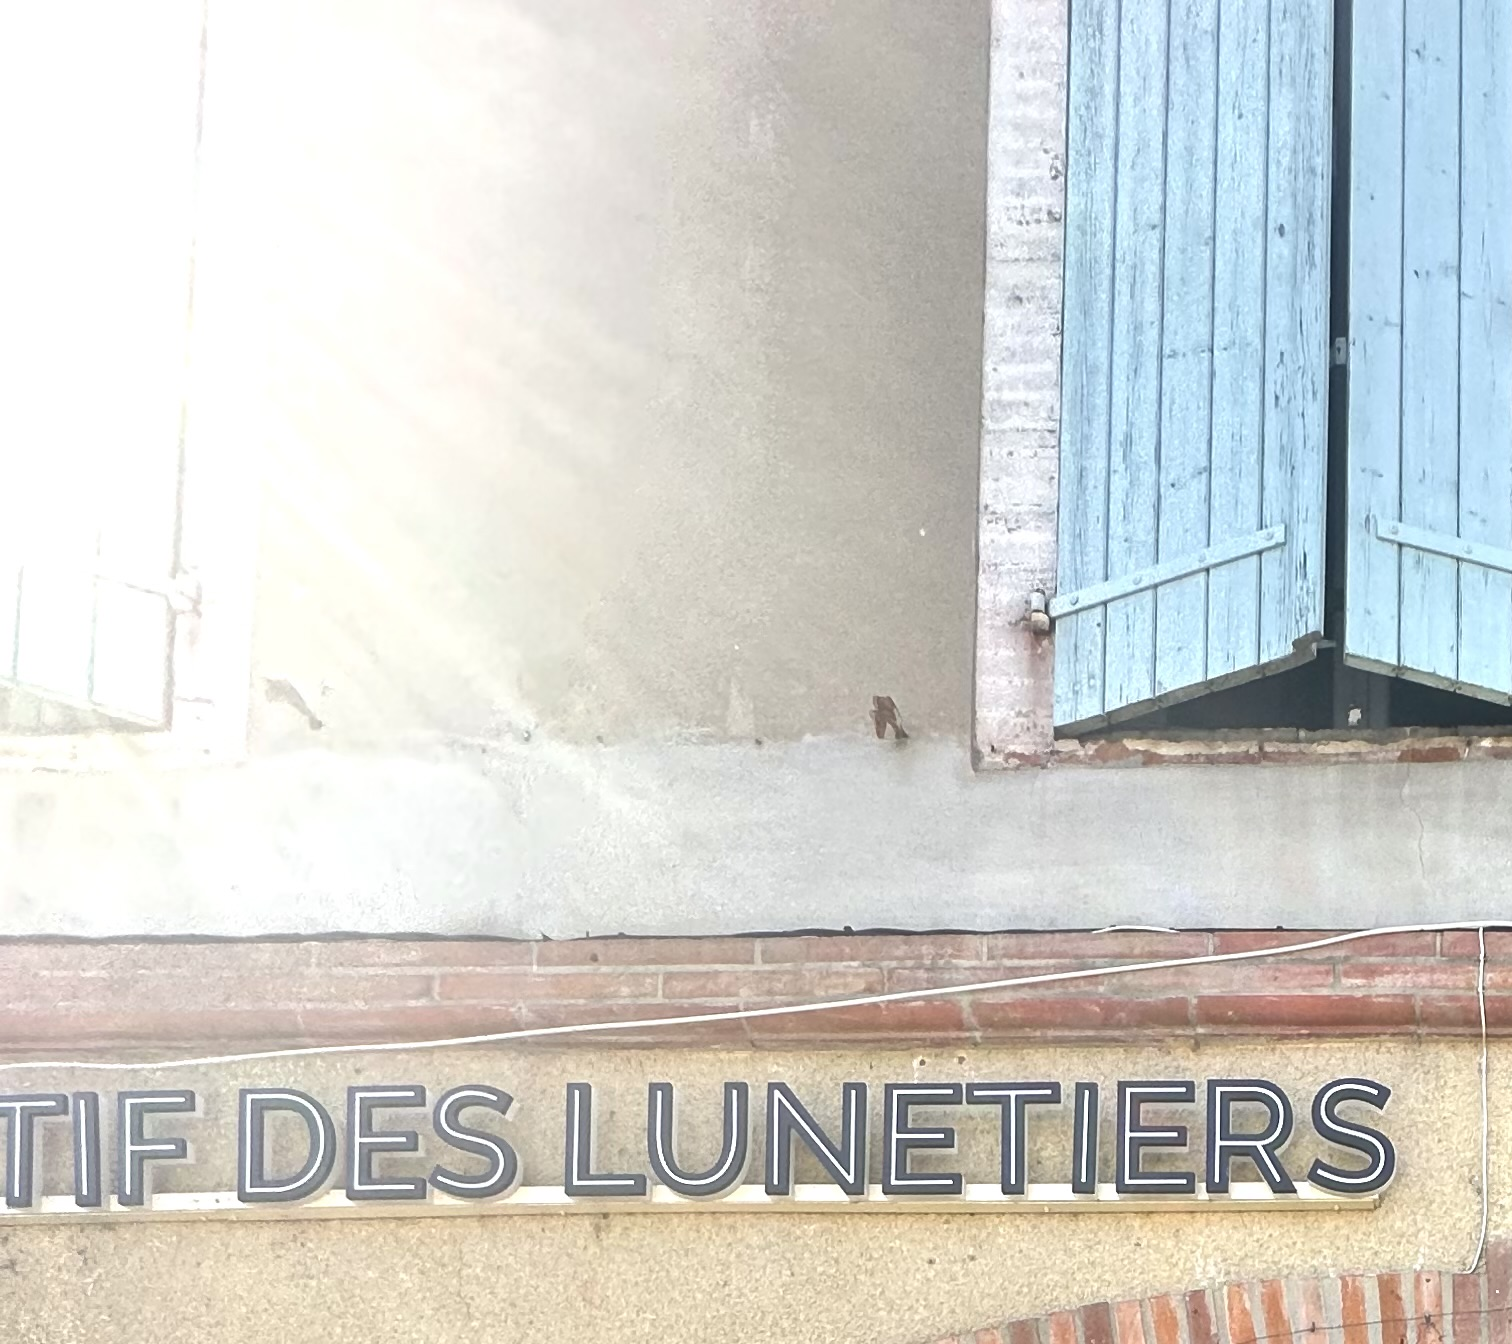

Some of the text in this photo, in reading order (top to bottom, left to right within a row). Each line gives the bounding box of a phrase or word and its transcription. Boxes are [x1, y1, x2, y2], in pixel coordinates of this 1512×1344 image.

[0, 1077, 1398, 1207] TIF DES LUNETIERS
